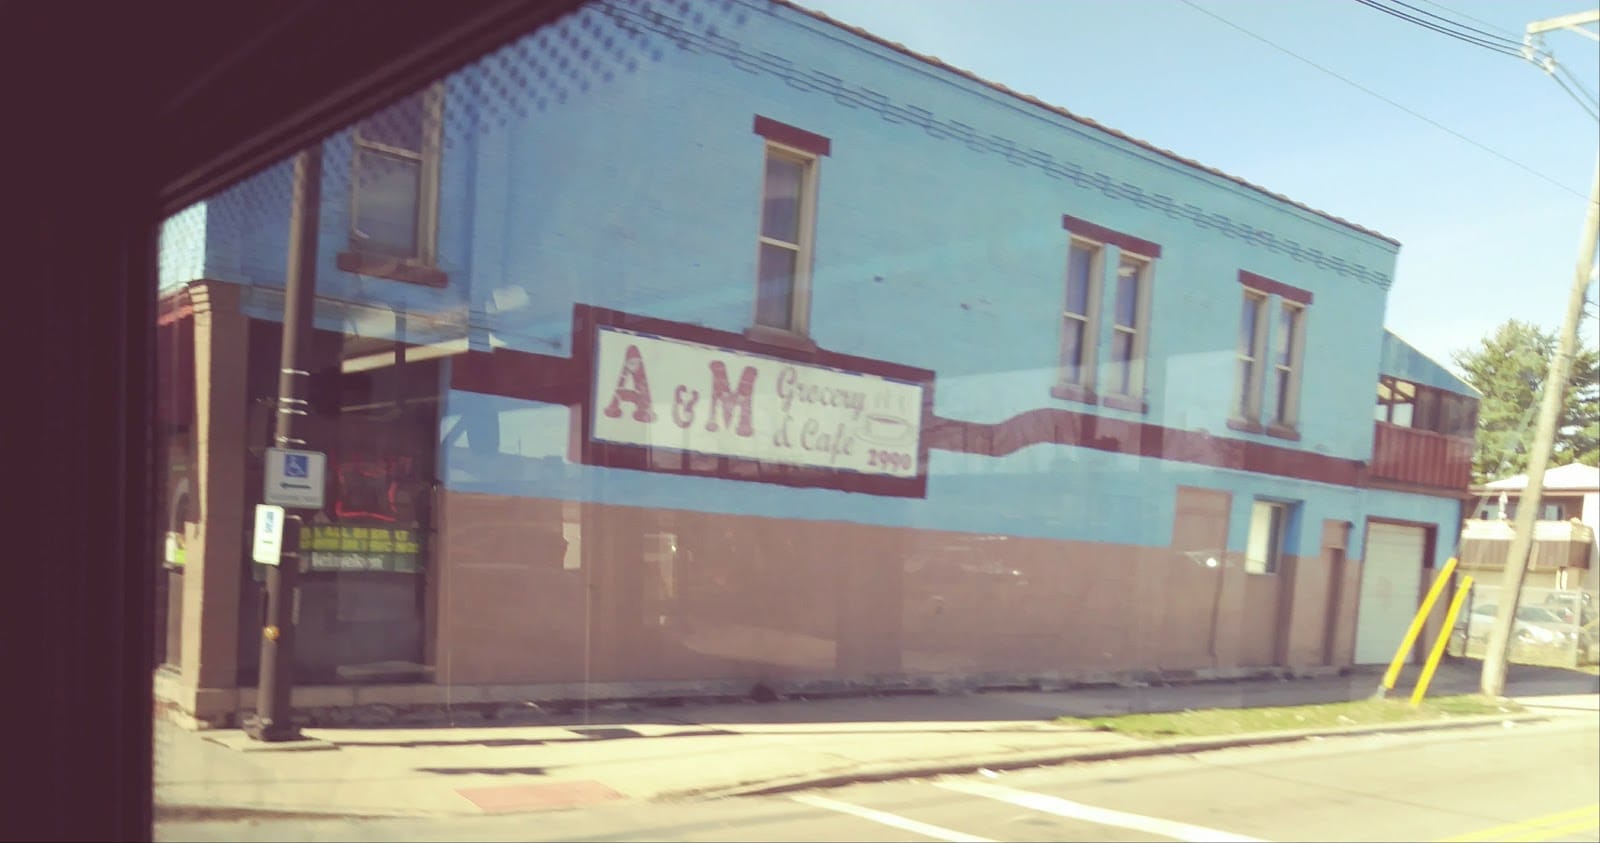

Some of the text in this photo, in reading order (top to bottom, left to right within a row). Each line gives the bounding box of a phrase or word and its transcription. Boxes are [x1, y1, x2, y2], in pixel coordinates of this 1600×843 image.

[603, 344, 758, 437] A & M
[776, 366, 867, 420] Grocery
